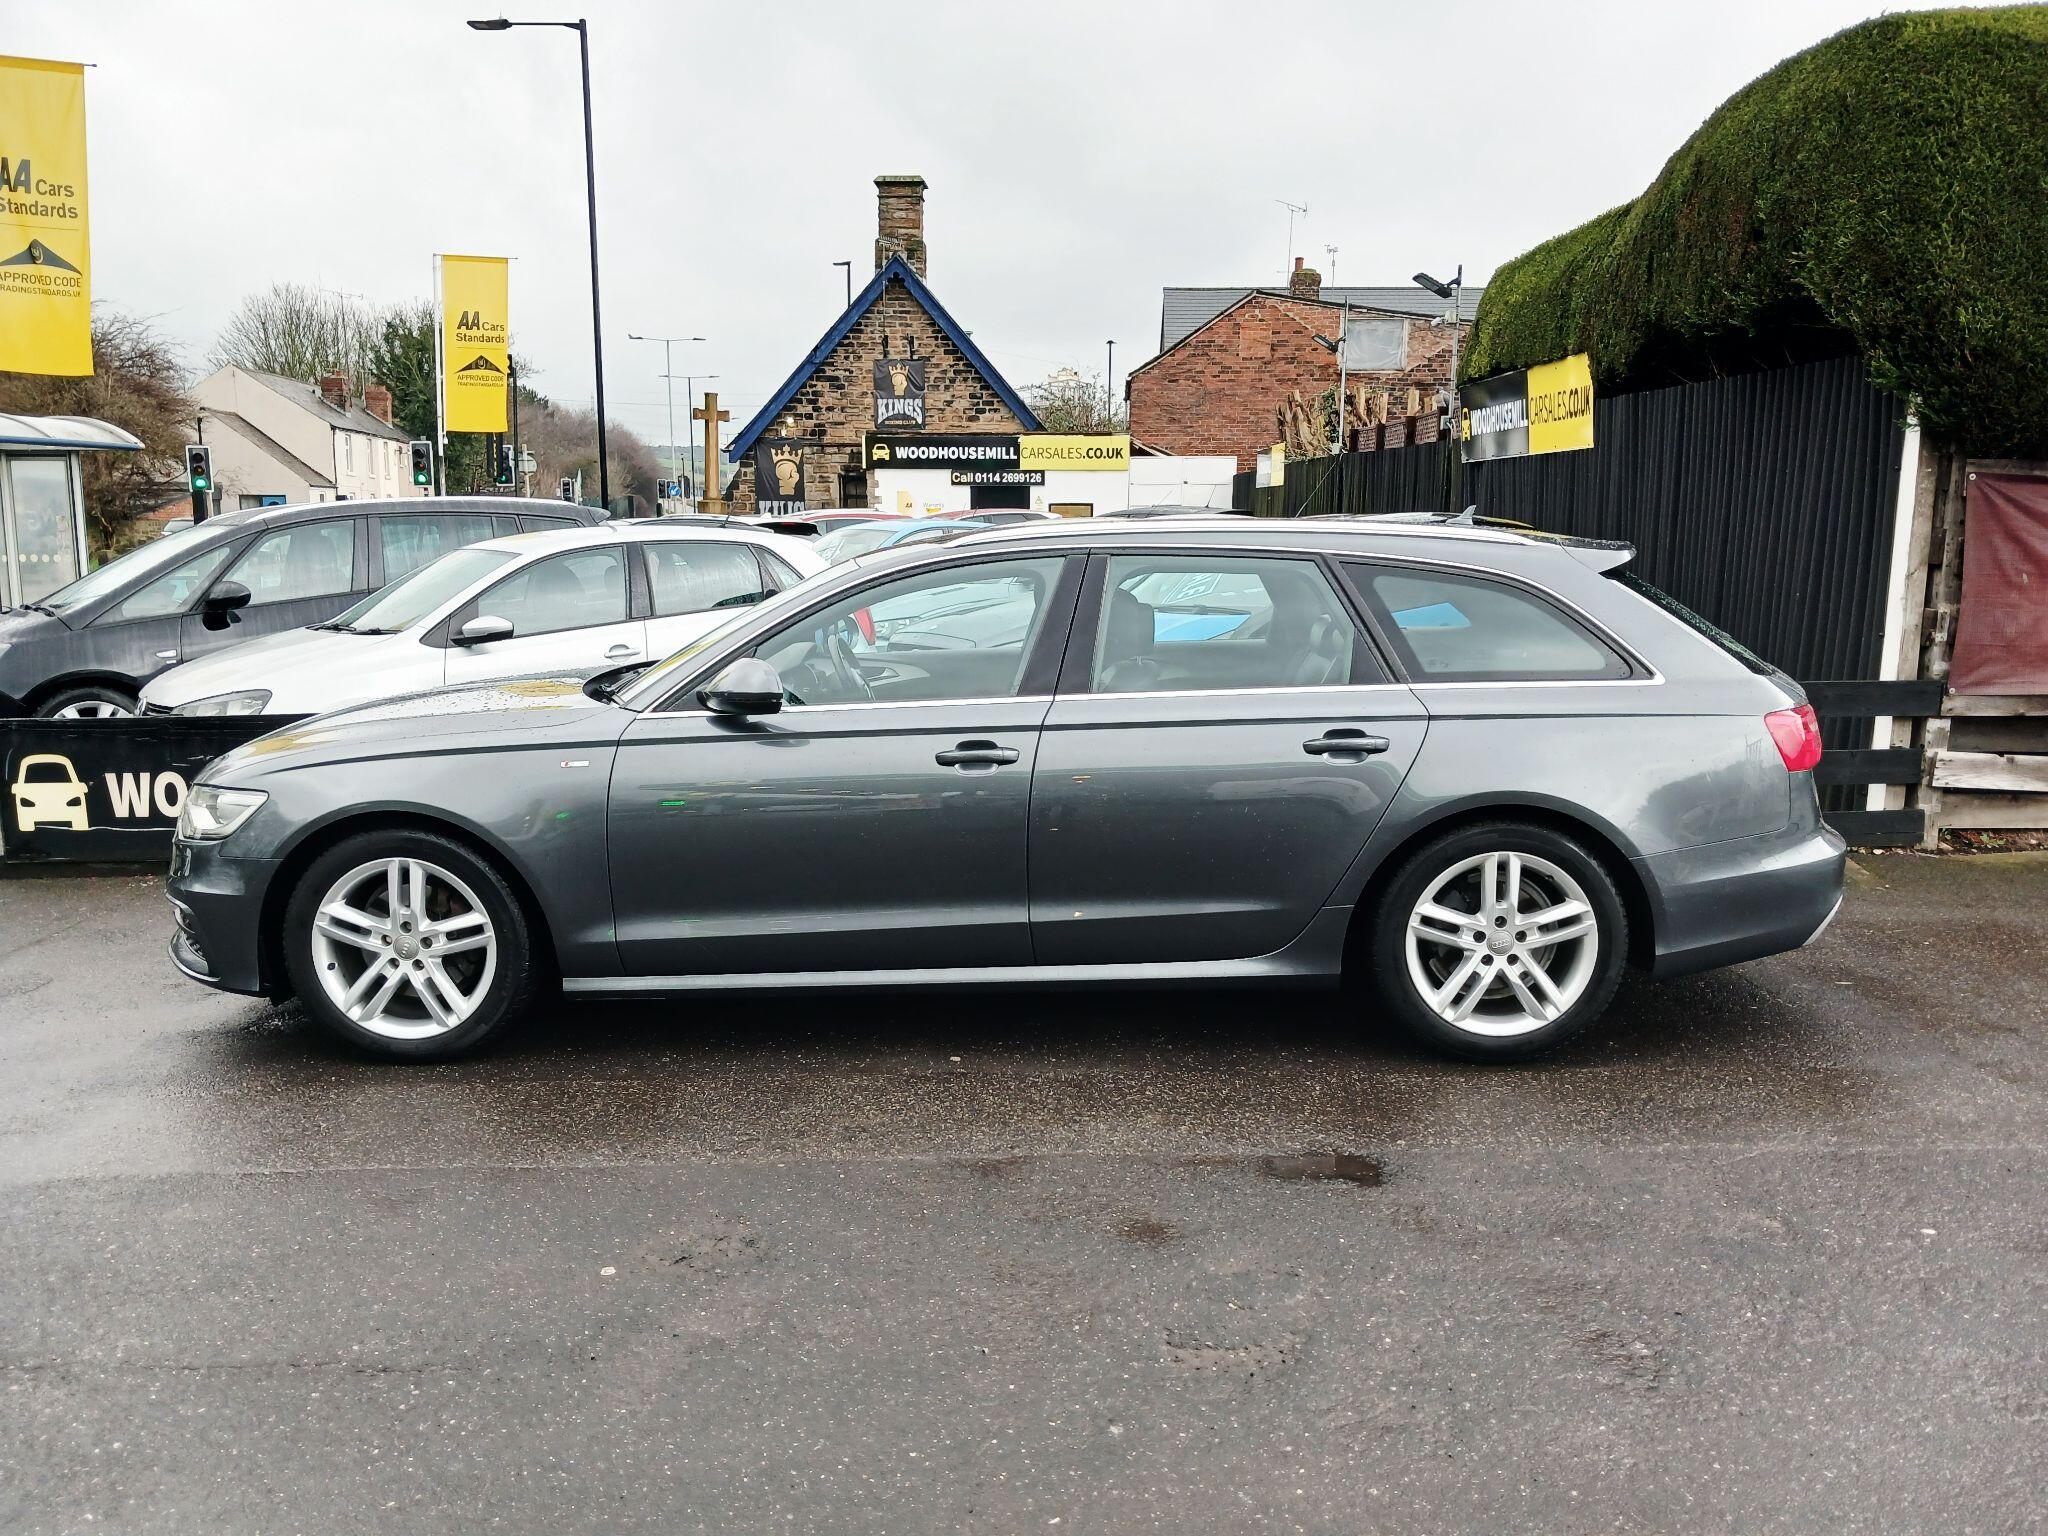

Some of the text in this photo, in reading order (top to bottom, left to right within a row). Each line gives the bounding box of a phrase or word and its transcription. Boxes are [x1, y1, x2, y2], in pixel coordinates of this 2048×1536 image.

[0, 156, 75, 198] AA Cars
[53, 276, 81, 288] CODE
[456, 311, 505, 332] AA Cars
[456, 333, 505, 344] Standards
[876, 398, 923, 425] KINGS
[1470, 384, 1592, 437] WOODHOUSEMILL CARSALES.CO.UK
[895, 446, 1124, 460] WOODHOUSEMILL CARSALES.CO.UK
[951, 472, 1042, 483] Call 0114 2699126
